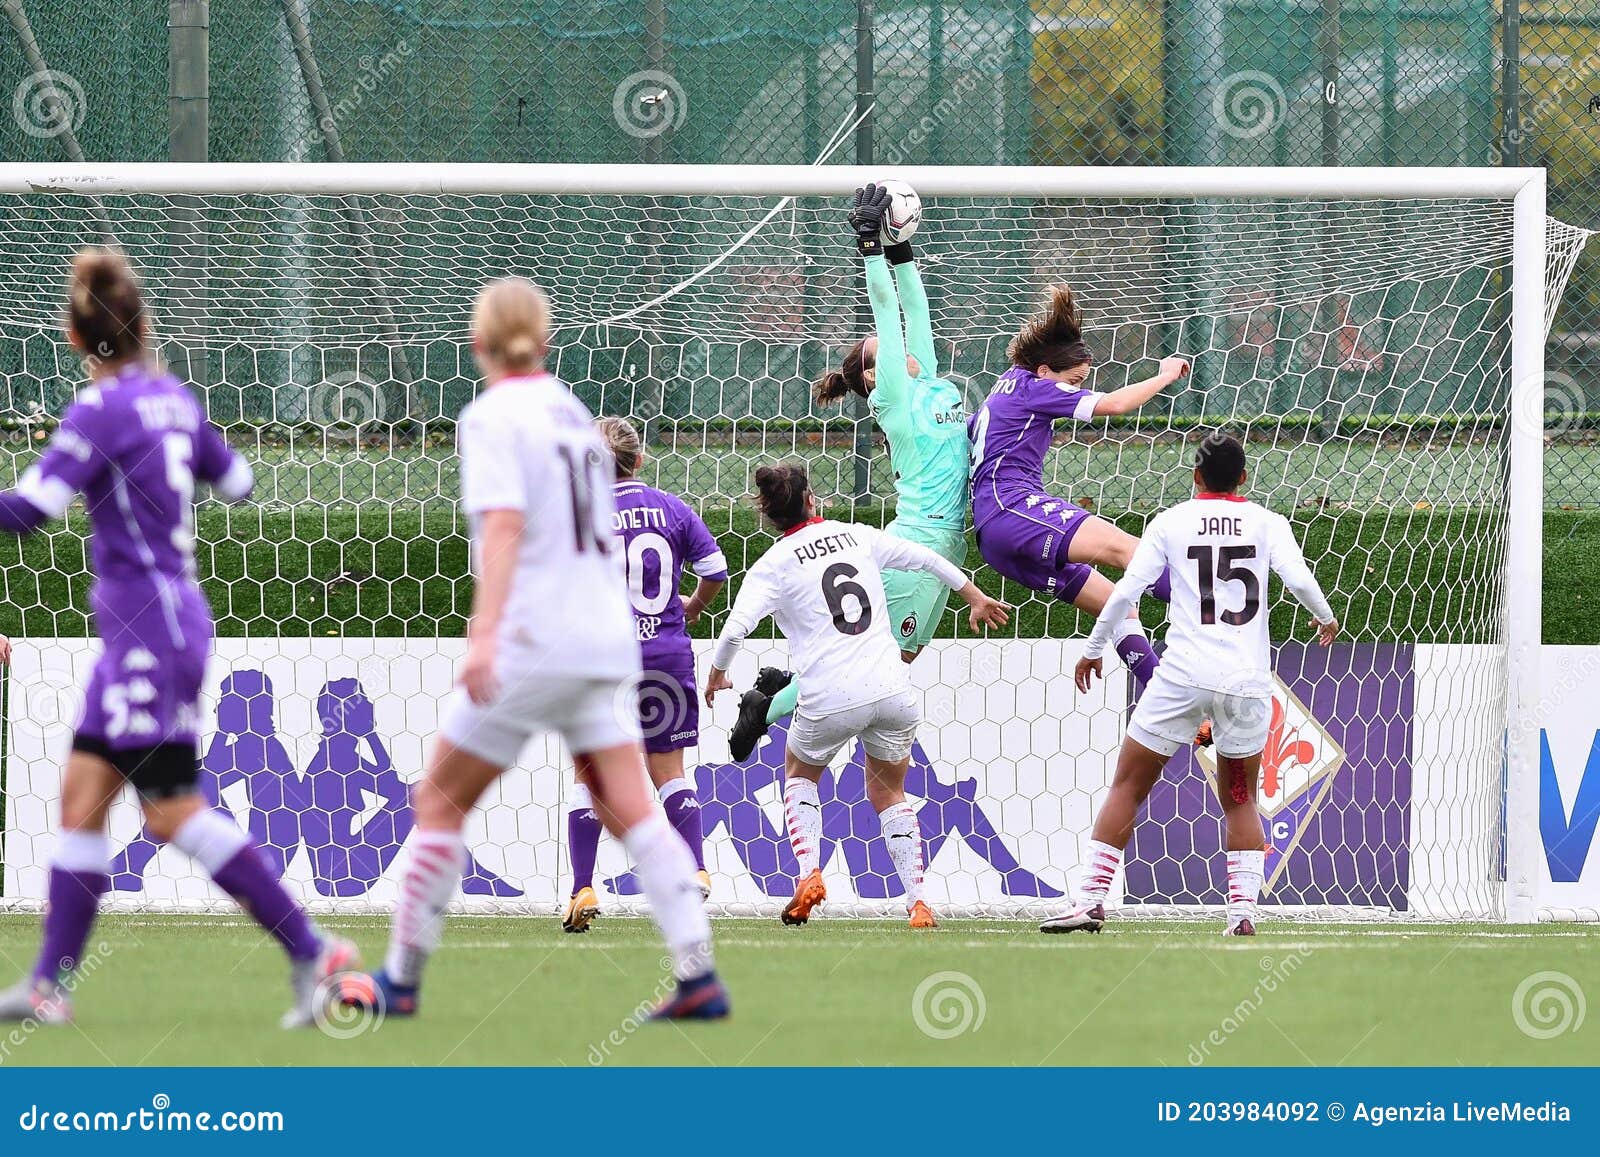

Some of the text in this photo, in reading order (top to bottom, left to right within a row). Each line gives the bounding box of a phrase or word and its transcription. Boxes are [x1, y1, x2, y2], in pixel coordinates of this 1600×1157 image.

[610, 507, 667, 531] ONETTI
[1198, 517, 1242, 536] JANE
[614, 532, 673, 615] 0
[794, 532, 858, 564] FUSETTI
[821, 562, 872, 635] 6
[1187, 545, 1260, 626] 15
